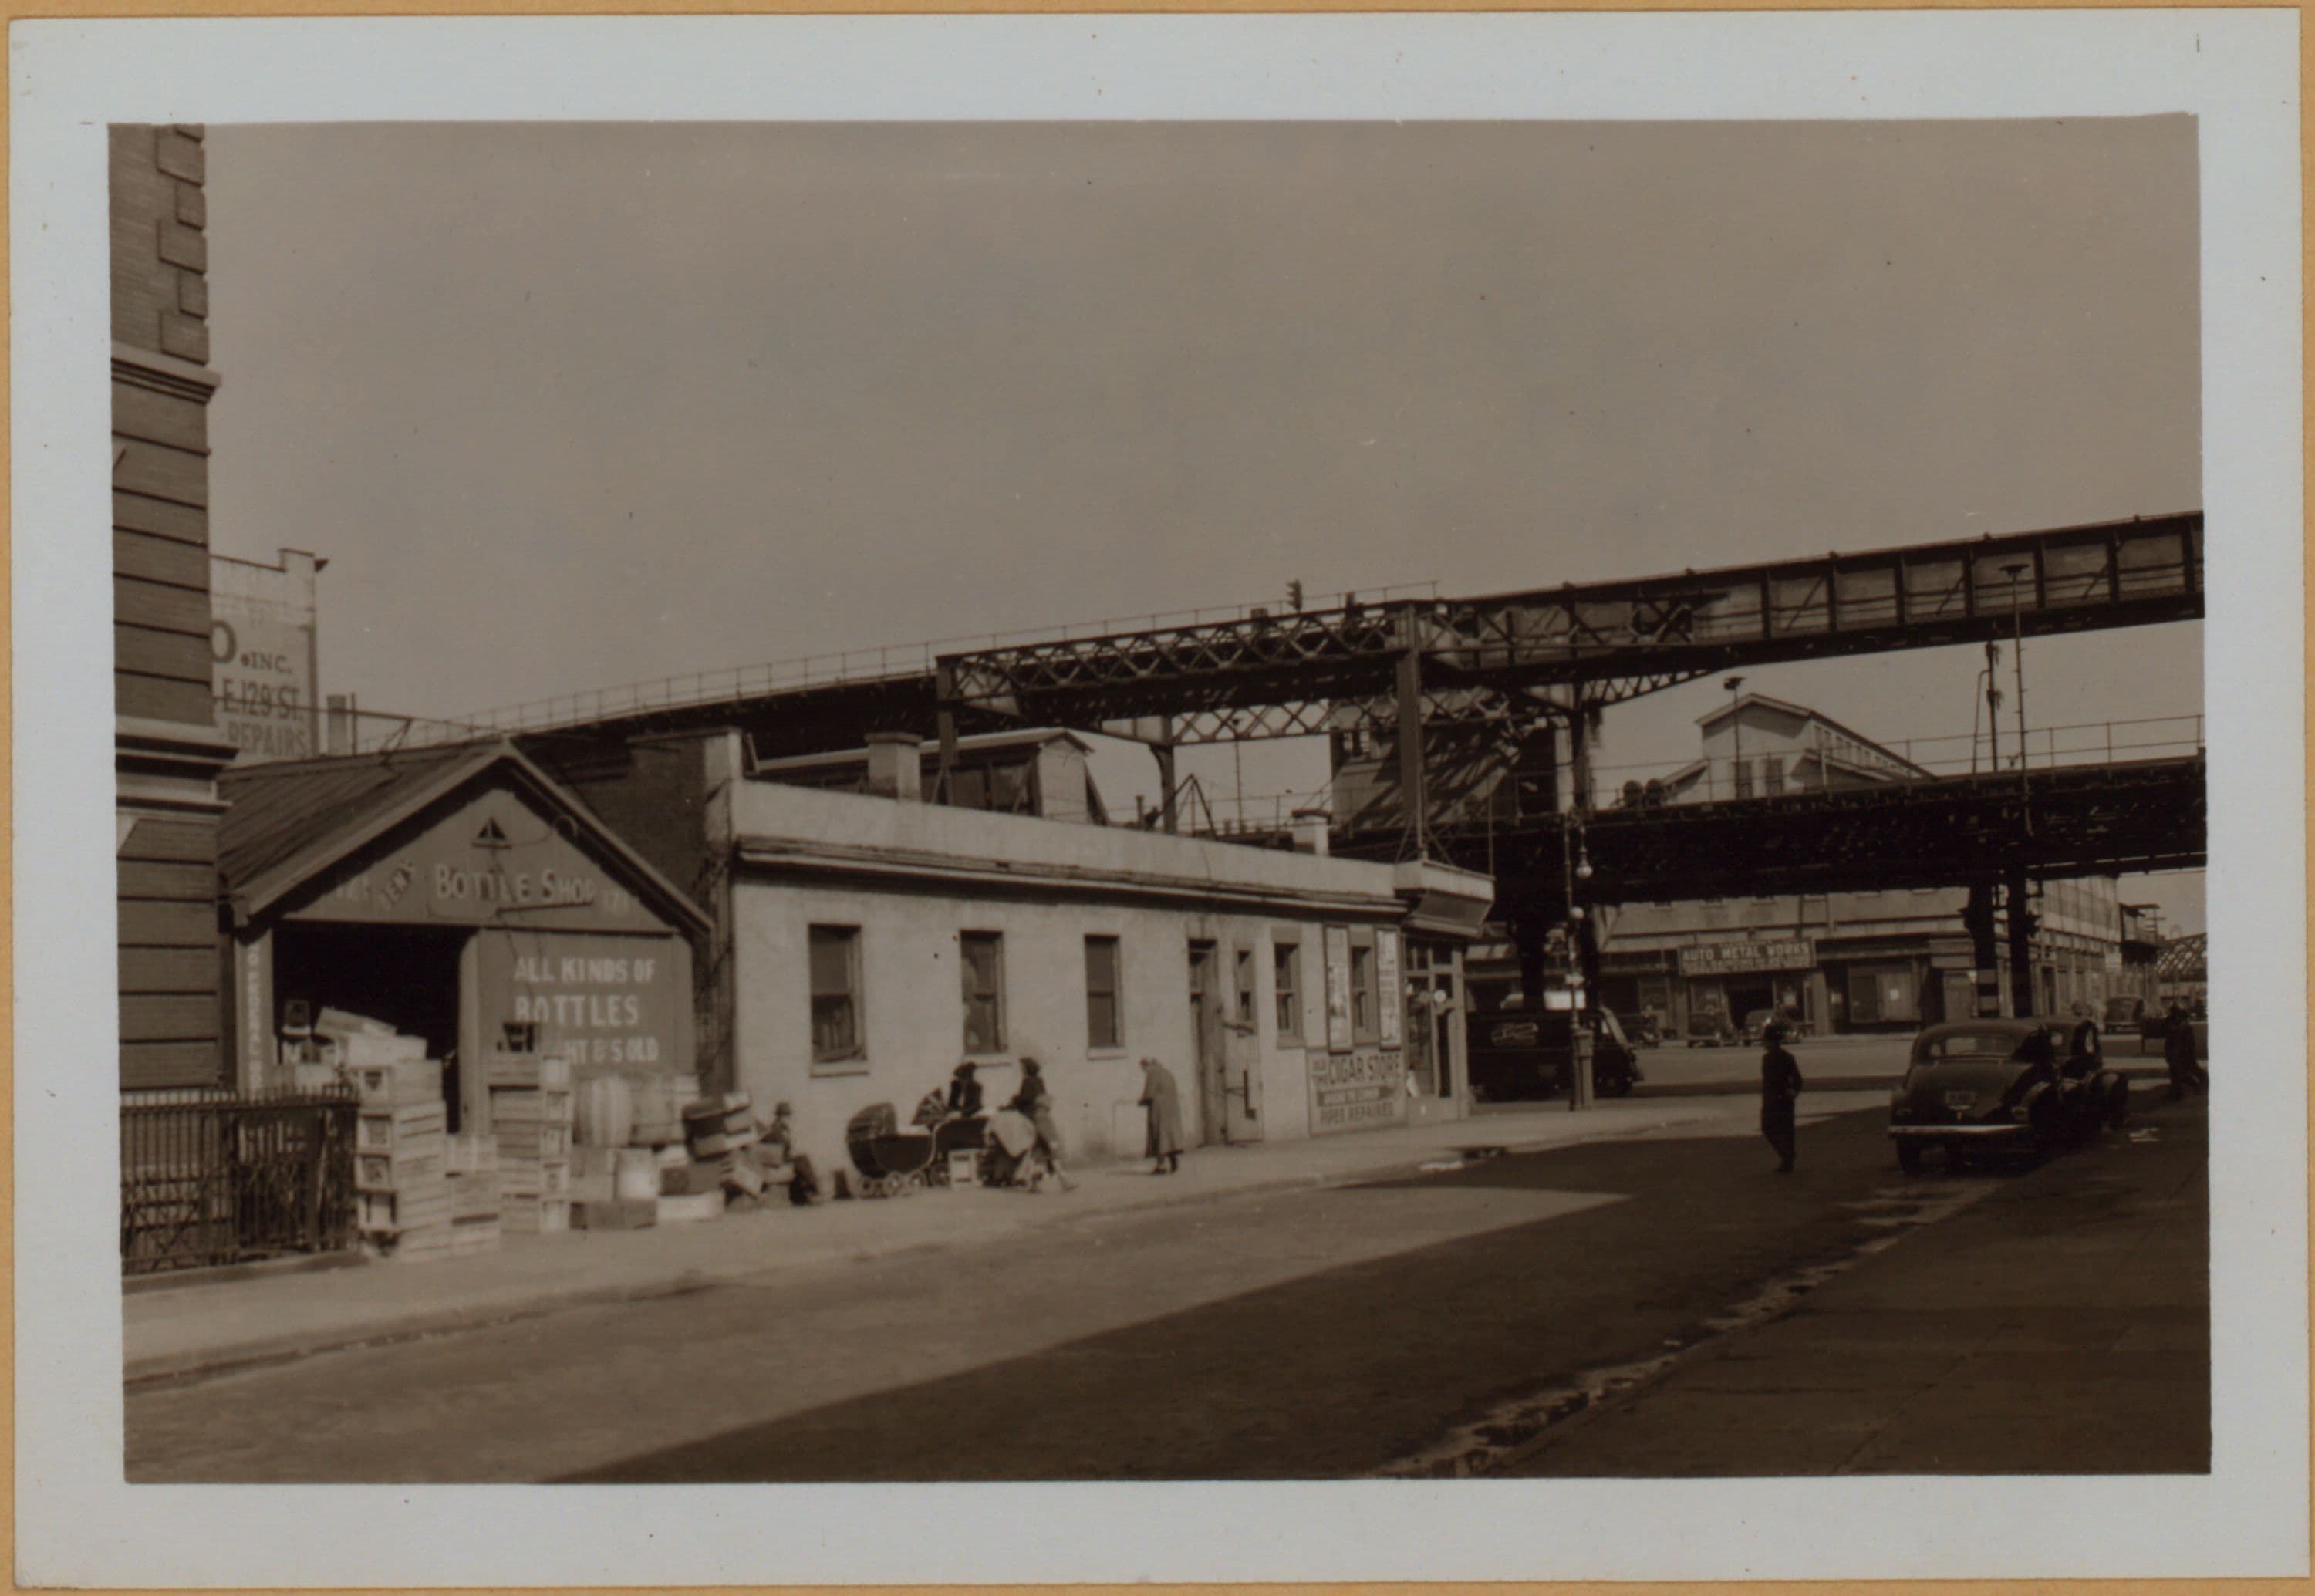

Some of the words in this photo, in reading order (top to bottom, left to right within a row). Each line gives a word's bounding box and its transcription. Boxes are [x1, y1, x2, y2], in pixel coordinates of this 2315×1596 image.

[434, 864, 532, 903] BOTTLE
[541, 869, 595, 903] SHOP
[1682, 948, 1715, 961] AUTO
[1721, 945, 1761, 959] METAL
[1766, 941, 1810, 956] WORKS
[513, 957, 555, 983] ALL
[561, 957, 629, 983] KINDS
[633, 957, 656, 982] OF
[514, 994, 641, 1027] BOTTLES
[610, 1036, 660, 1063] SOLD
